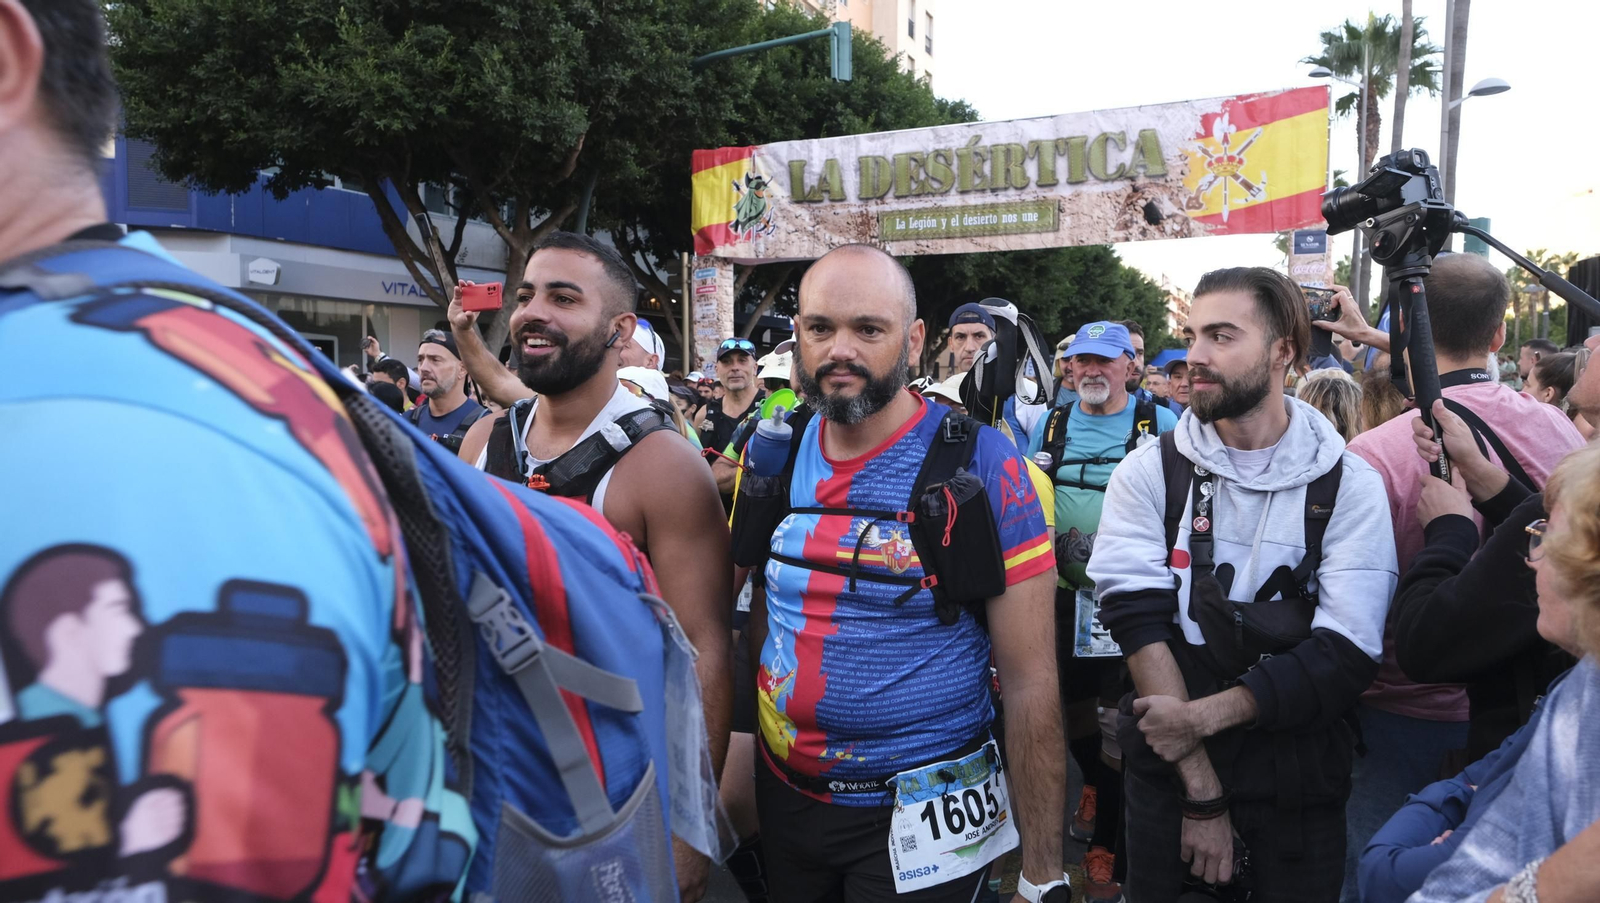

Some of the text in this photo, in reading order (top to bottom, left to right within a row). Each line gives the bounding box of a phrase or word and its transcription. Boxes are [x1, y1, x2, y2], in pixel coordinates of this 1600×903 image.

[788, 129, 1168, 203] LA DESÉRTICA
[895, 211, 1039, 231] La Legión y el desierto nos une
[920, 781, 999, 841] 1605
[899, 866, 931, 882] asisa
